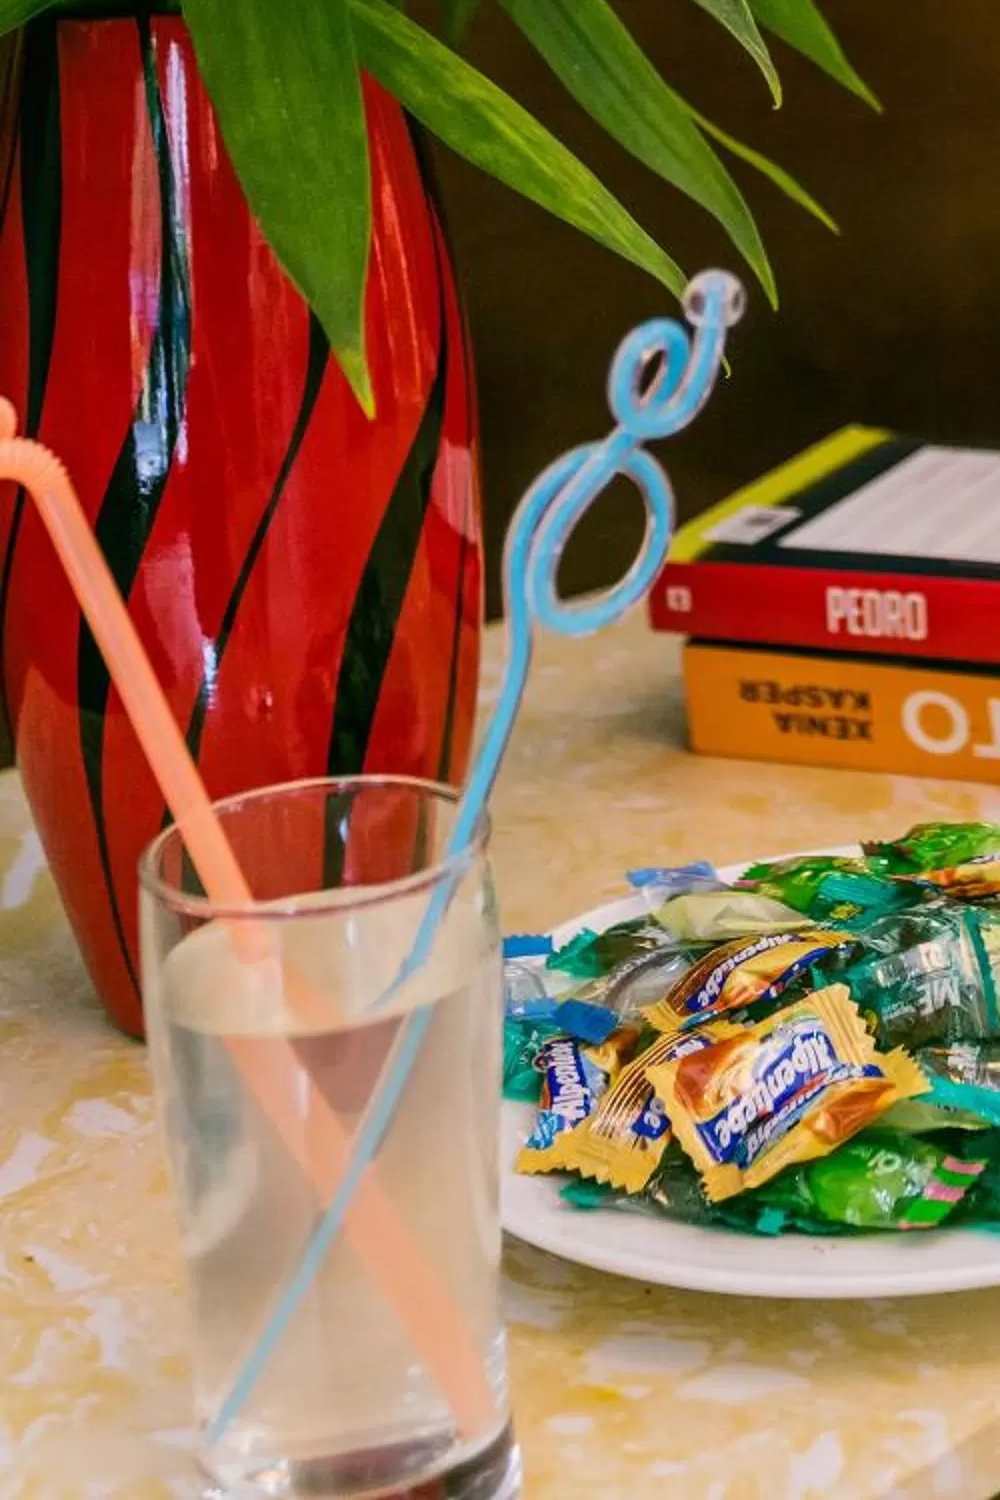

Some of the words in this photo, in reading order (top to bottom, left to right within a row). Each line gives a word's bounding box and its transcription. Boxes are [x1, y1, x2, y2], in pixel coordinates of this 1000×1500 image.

[825, 585, 927, 641] PEDRO
[738, 679, 871, 711] KASPER
[773, 712, 873, 741] XENIA
[712, 1031, 835, 1149] Alpenliebe
